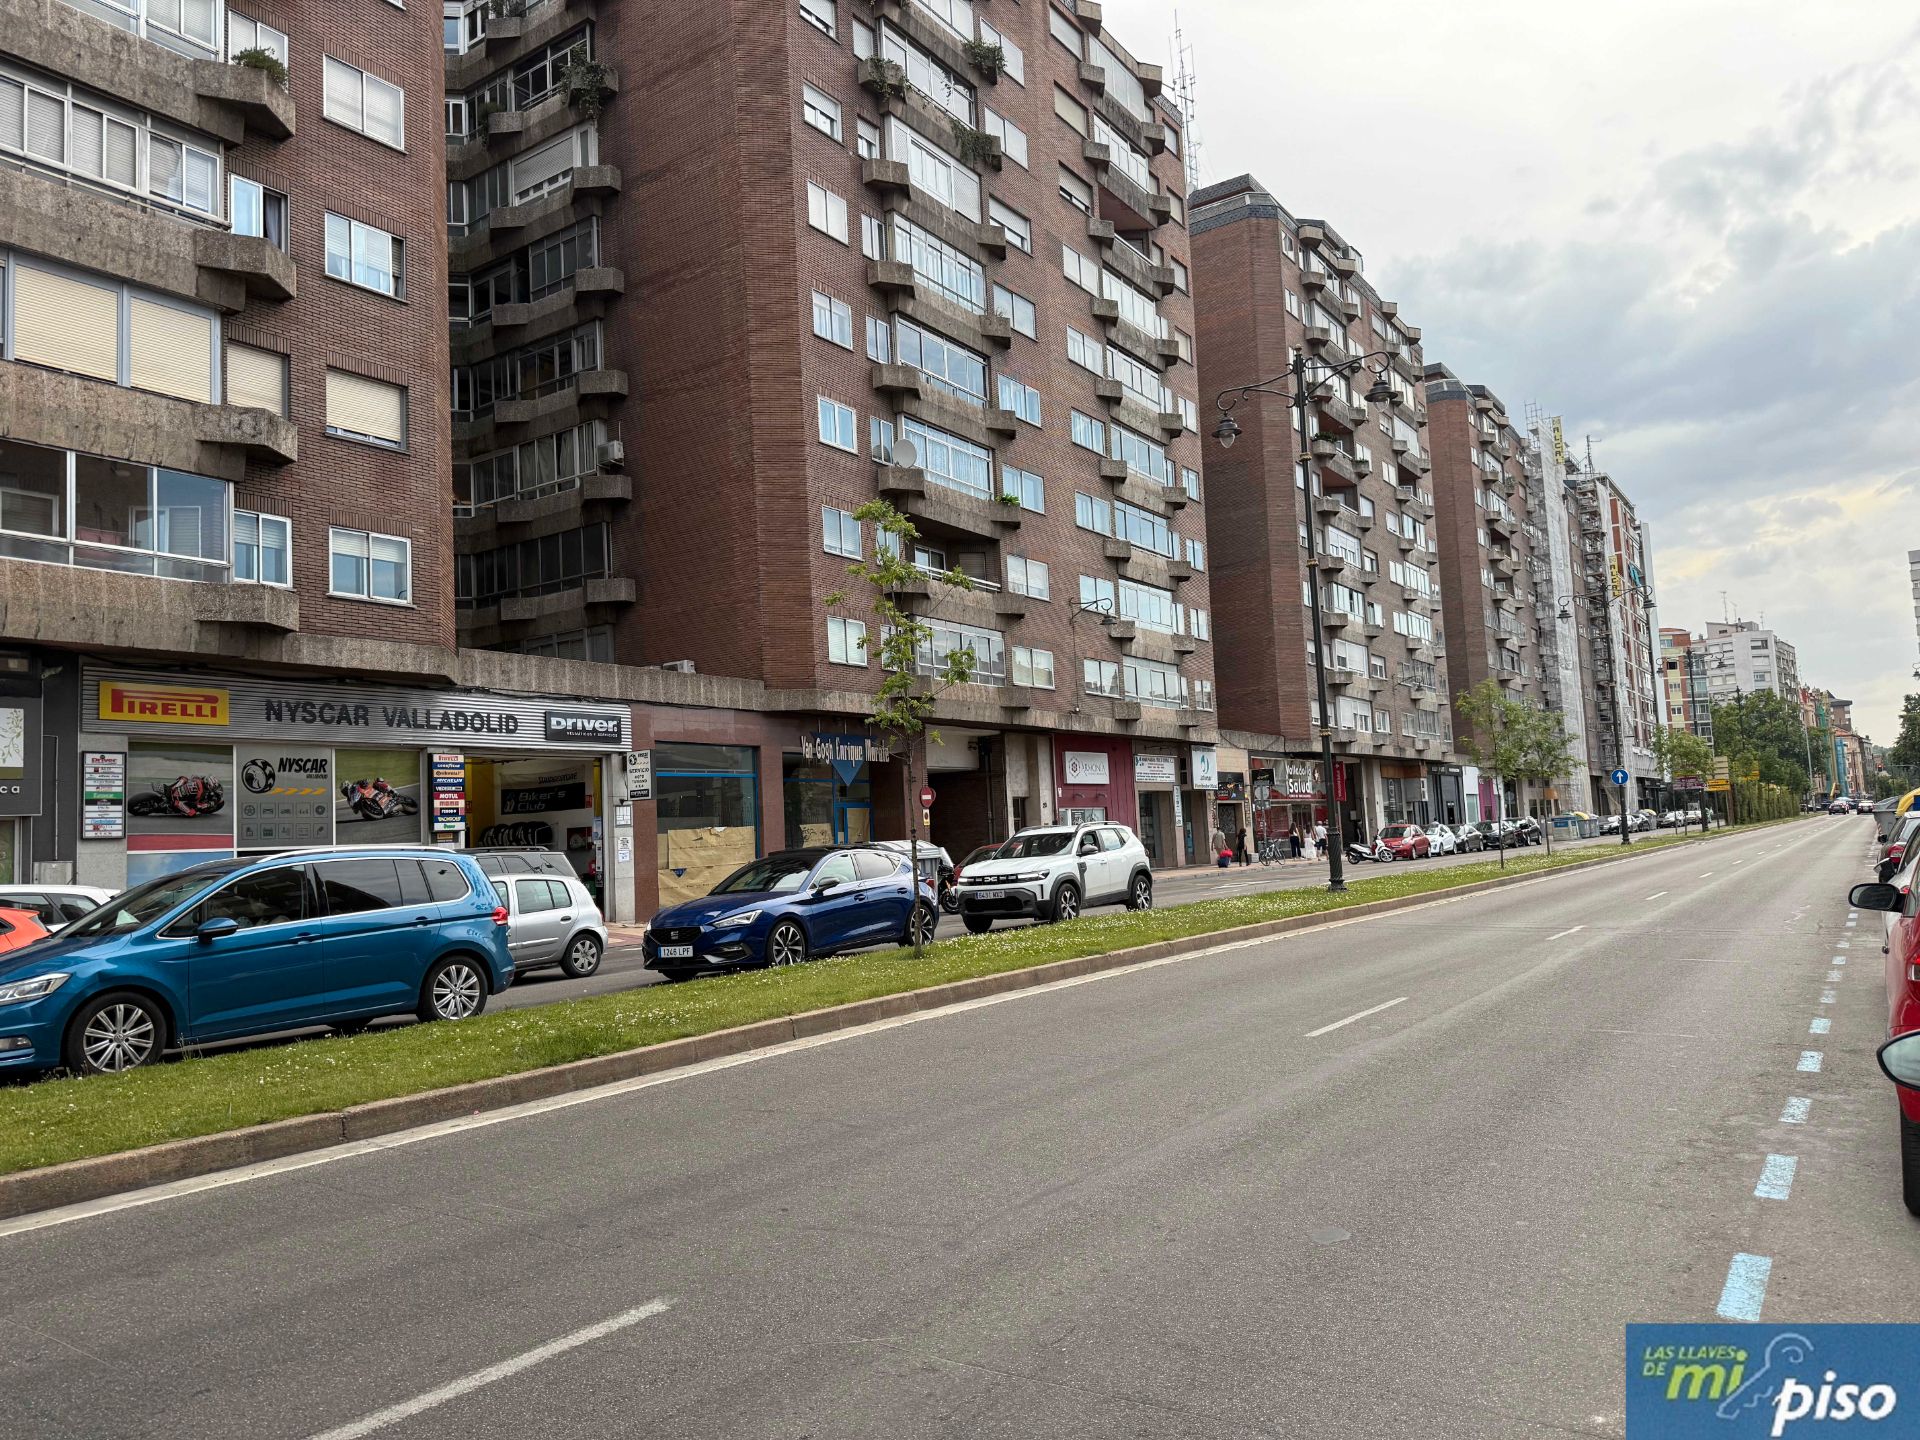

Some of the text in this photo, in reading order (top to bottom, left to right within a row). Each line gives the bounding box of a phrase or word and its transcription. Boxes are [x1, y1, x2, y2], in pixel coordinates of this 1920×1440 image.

[111, 688, 219, 718] PIRELLI
[264, 699, 520, 734] NYSCAR VALLADOLID
[801, 735, 813, 759] Van
[816, 737, 834, 764] Gogh
[836, 737, 863, 768] Enrique
[278, 757, 328, 773] NYSCAR
[1288, 779, 1312, 793] Salud
[517, 801, 545, 811] Club
